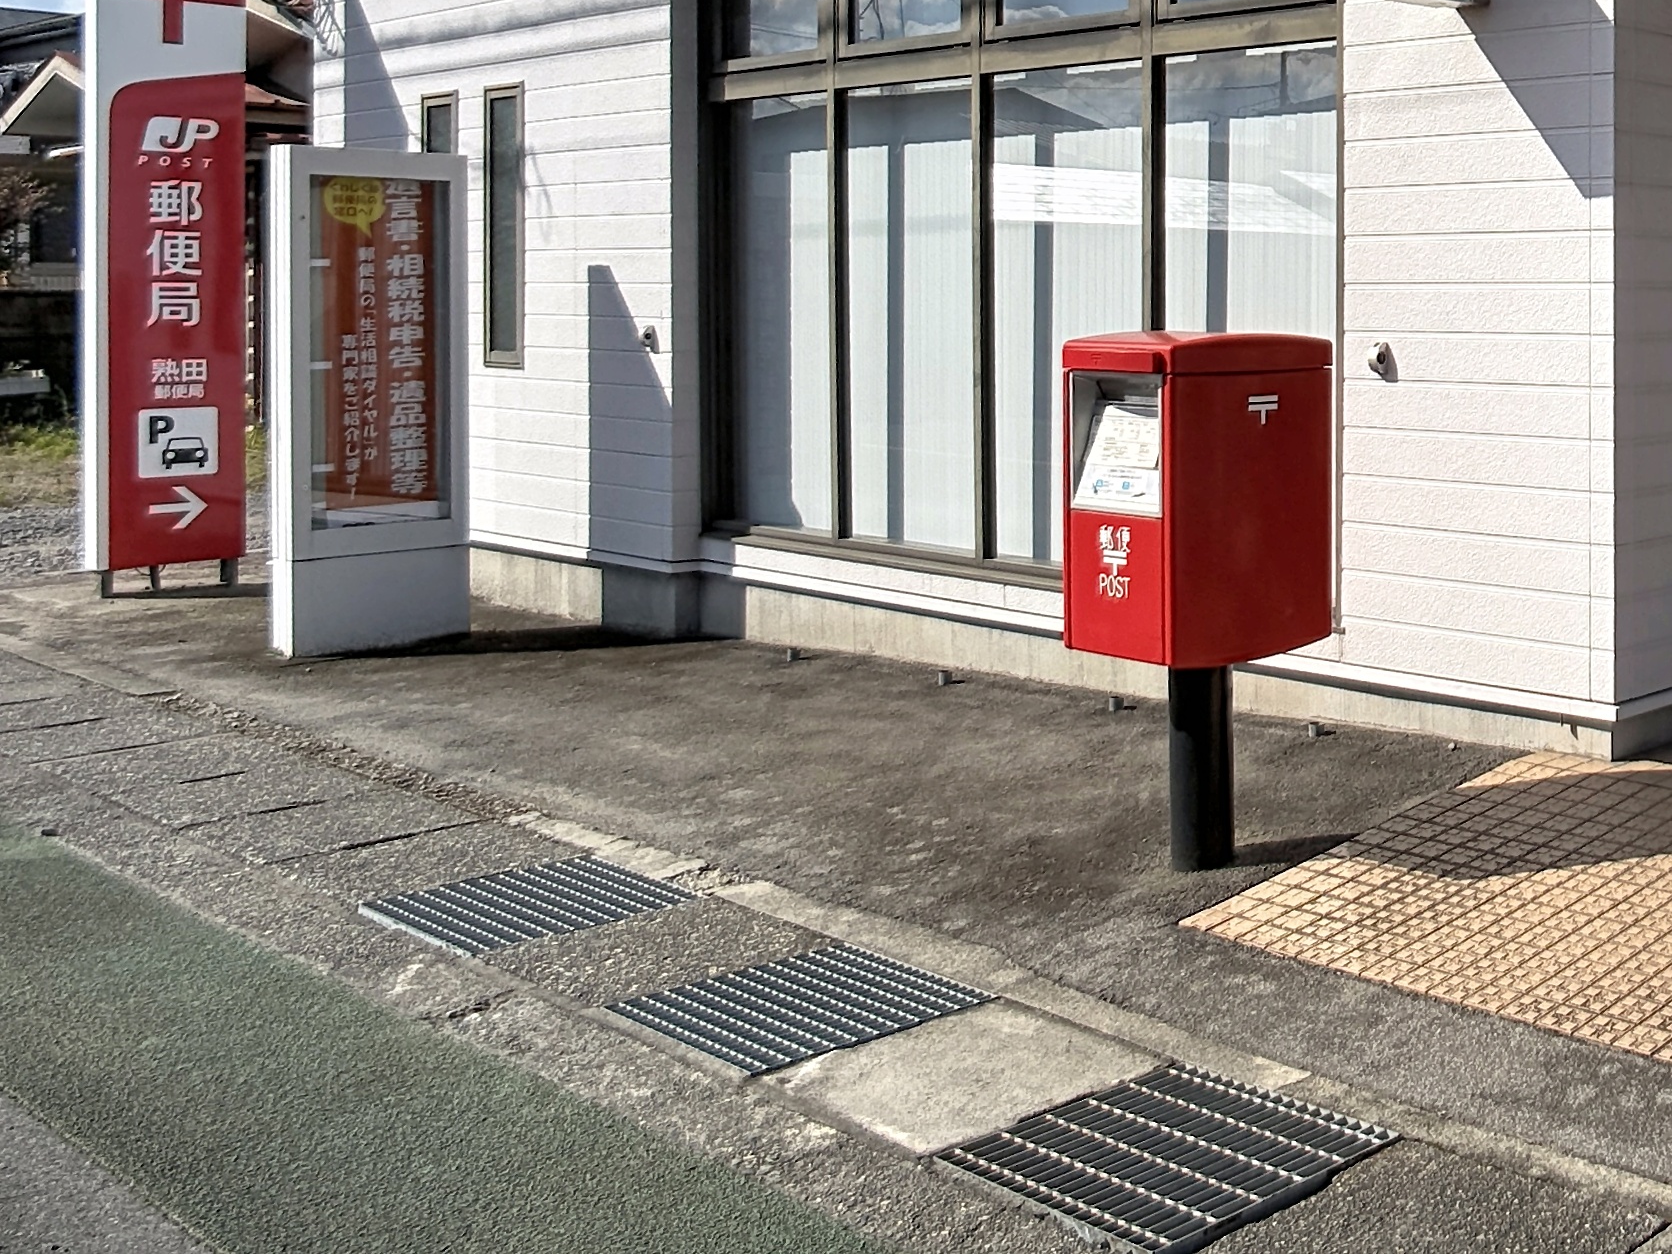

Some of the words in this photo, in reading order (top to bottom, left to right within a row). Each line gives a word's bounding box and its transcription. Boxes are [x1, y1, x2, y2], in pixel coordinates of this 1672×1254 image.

[141, 116, 220, 154] JP
[137, 155, 213, 169] POST
[146, 179, 203, 328] 郵便局
[151, 358, 208, 384] 熟田
[154, 383, 205, 399] 郵便局
[149, 415, 175, 445] P
[1099, 524, 1131, 553] 郵便
[1099, 573, 1131, 599] POST
